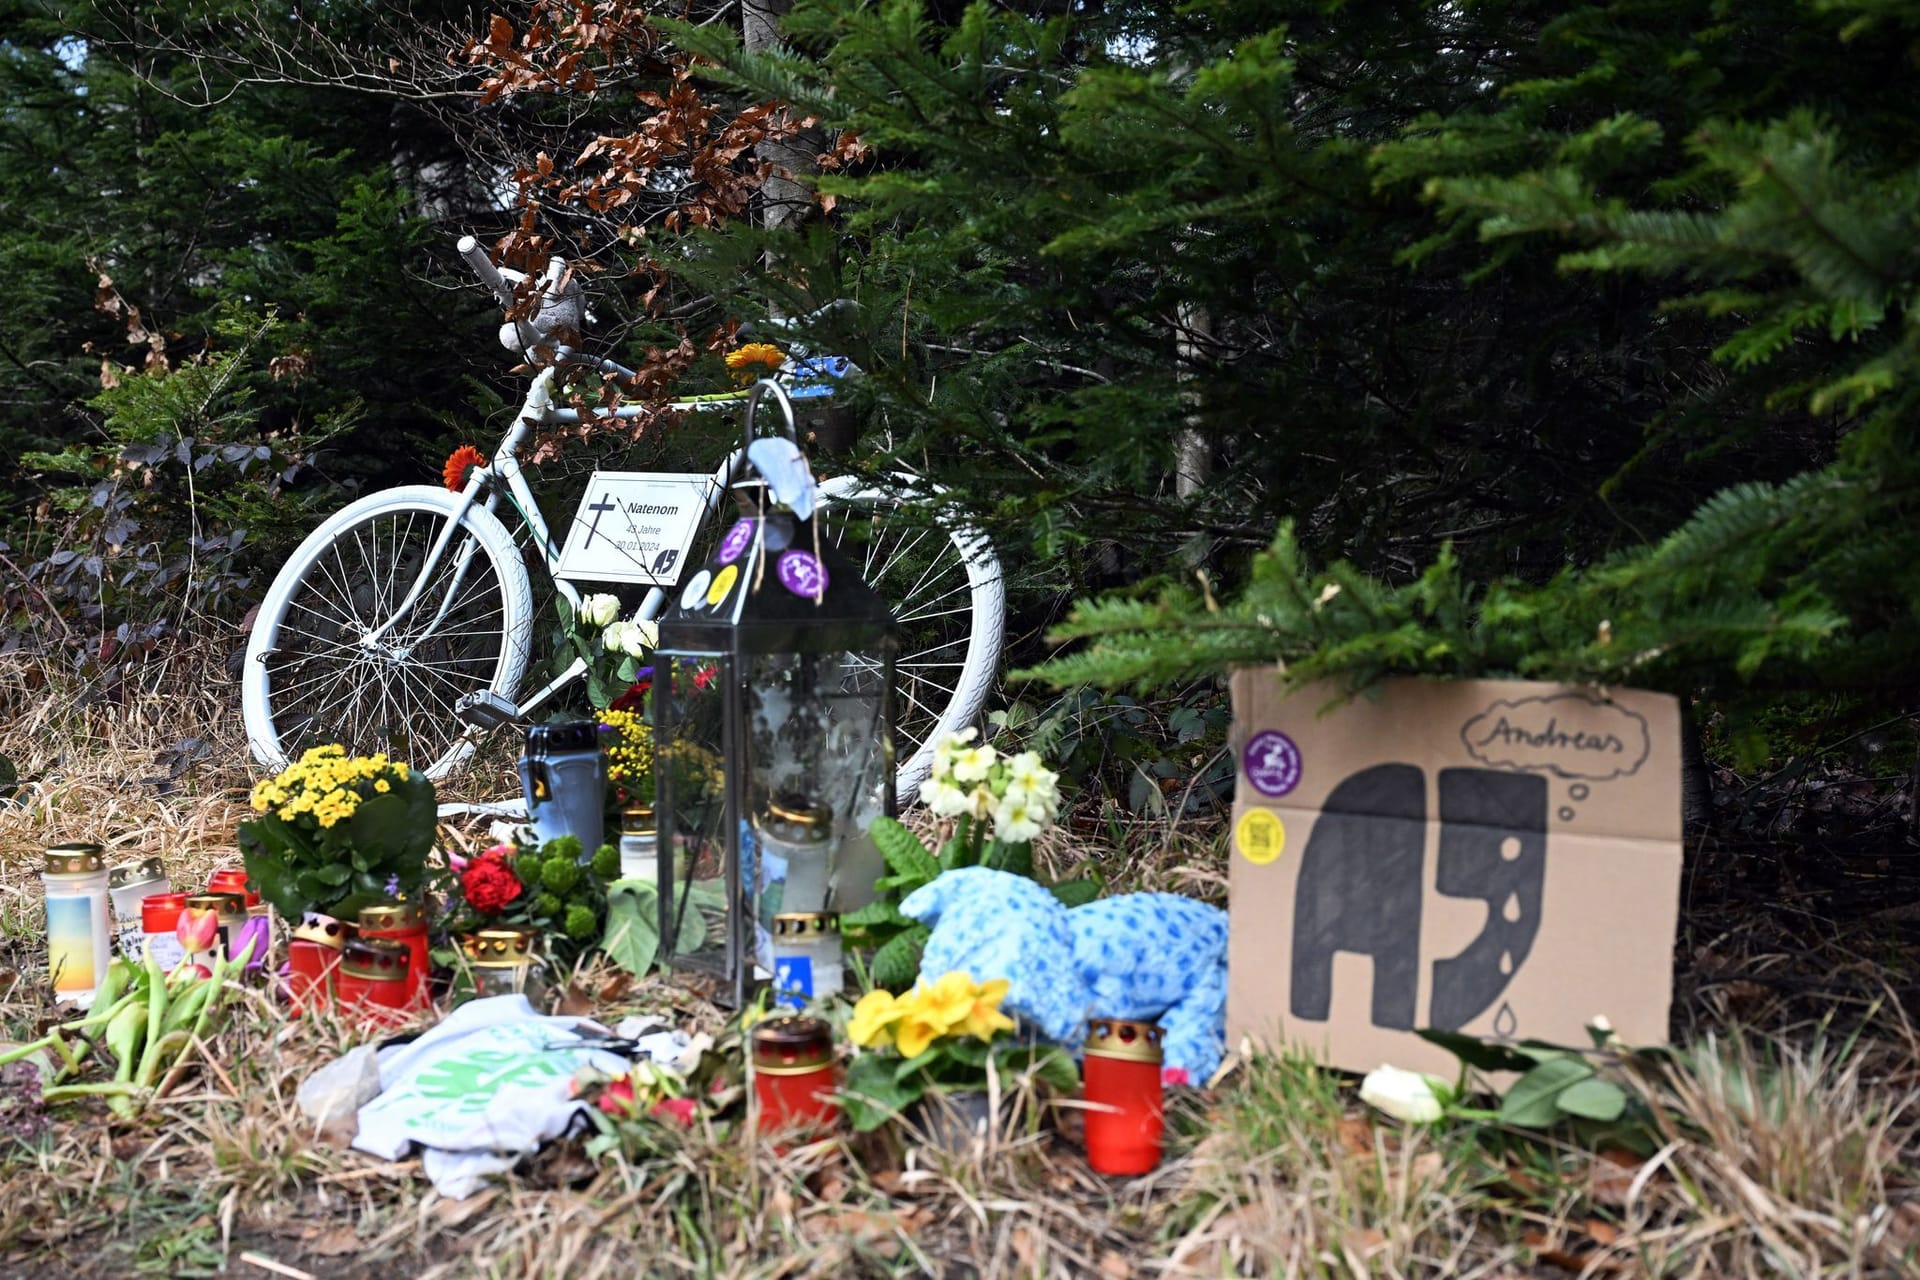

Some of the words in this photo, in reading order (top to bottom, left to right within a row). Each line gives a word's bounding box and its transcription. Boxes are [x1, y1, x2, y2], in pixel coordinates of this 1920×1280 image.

[627, 502, 678, 515] Natenom
[638, 525, 661, 535] Jahre
[1478, 716, 1623, 753] Andreas
